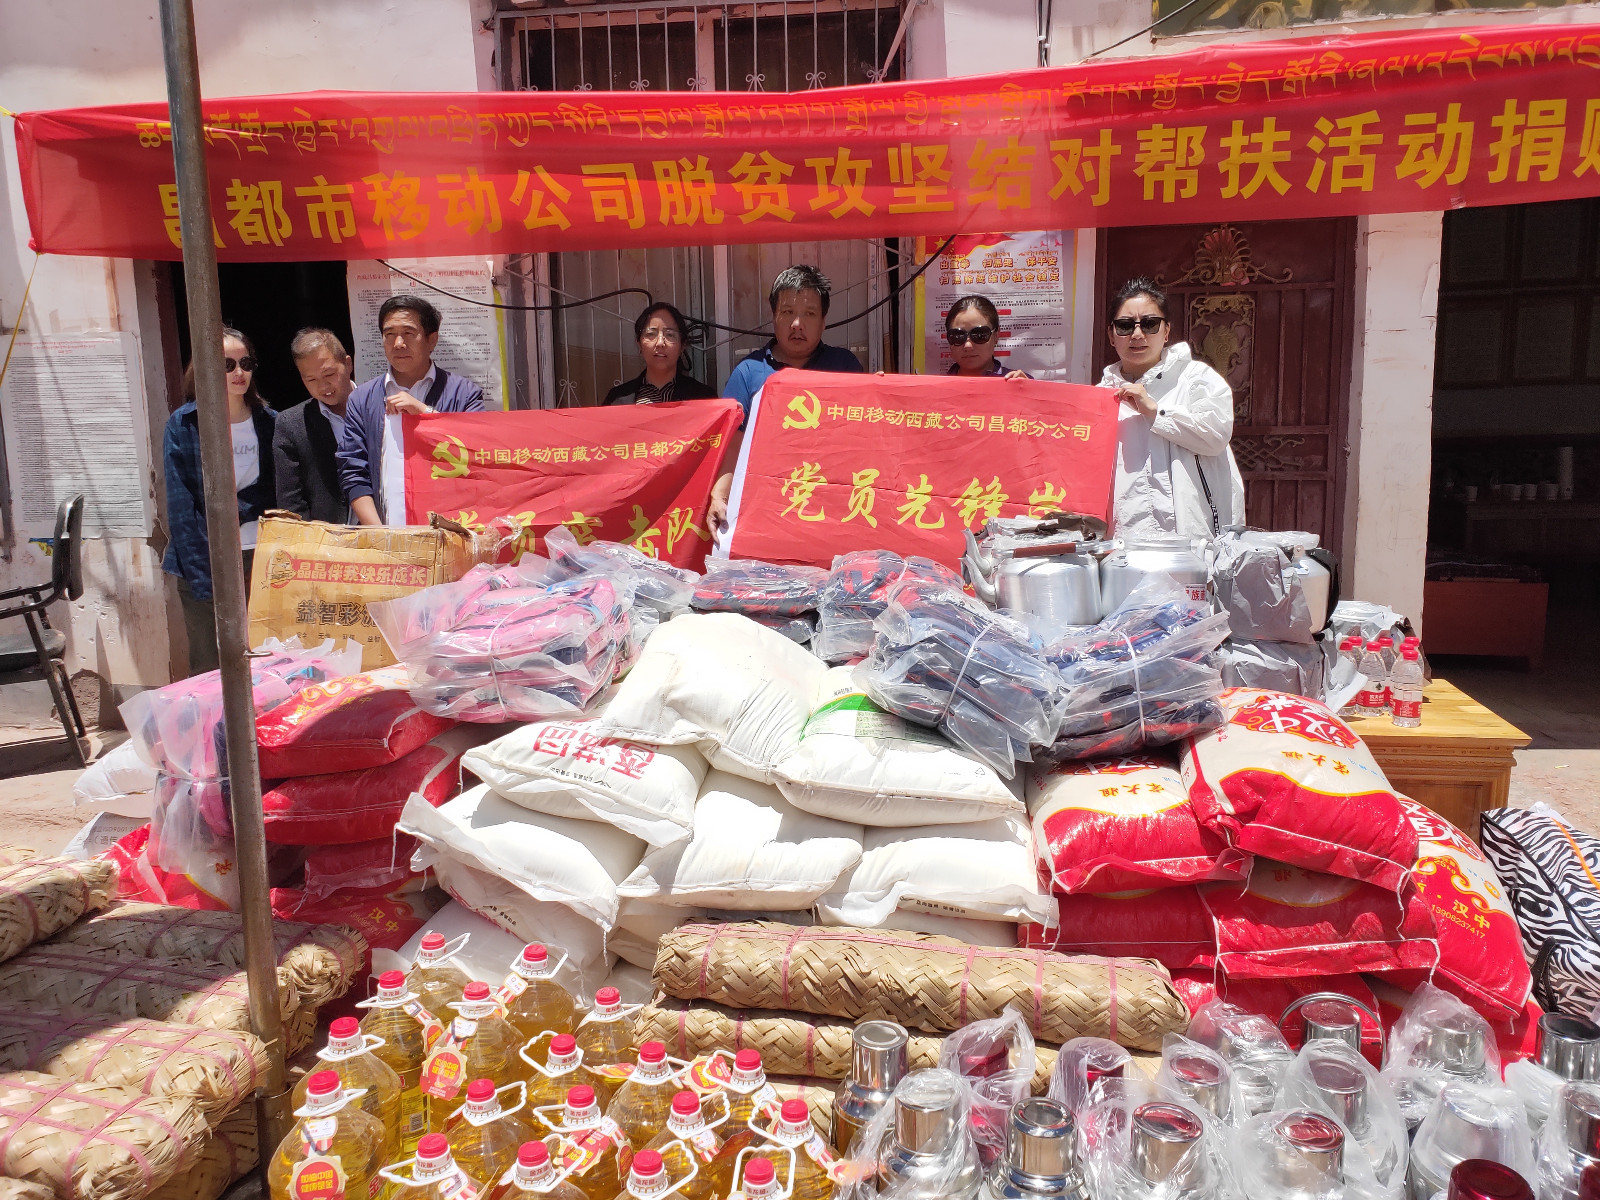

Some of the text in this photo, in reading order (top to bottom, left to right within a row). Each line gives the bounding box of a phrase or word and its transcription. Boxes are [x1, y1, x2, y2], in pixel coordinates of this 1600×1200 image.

[827, 403, 1091, 441] 中国移动西藏公司昌都分公司
[474, 433, 723, 466] 中国移动西藏公司昌都分公司
[368, 906, 399, 932] 汉中
[1452, 899, 1491, 929] 汉中
